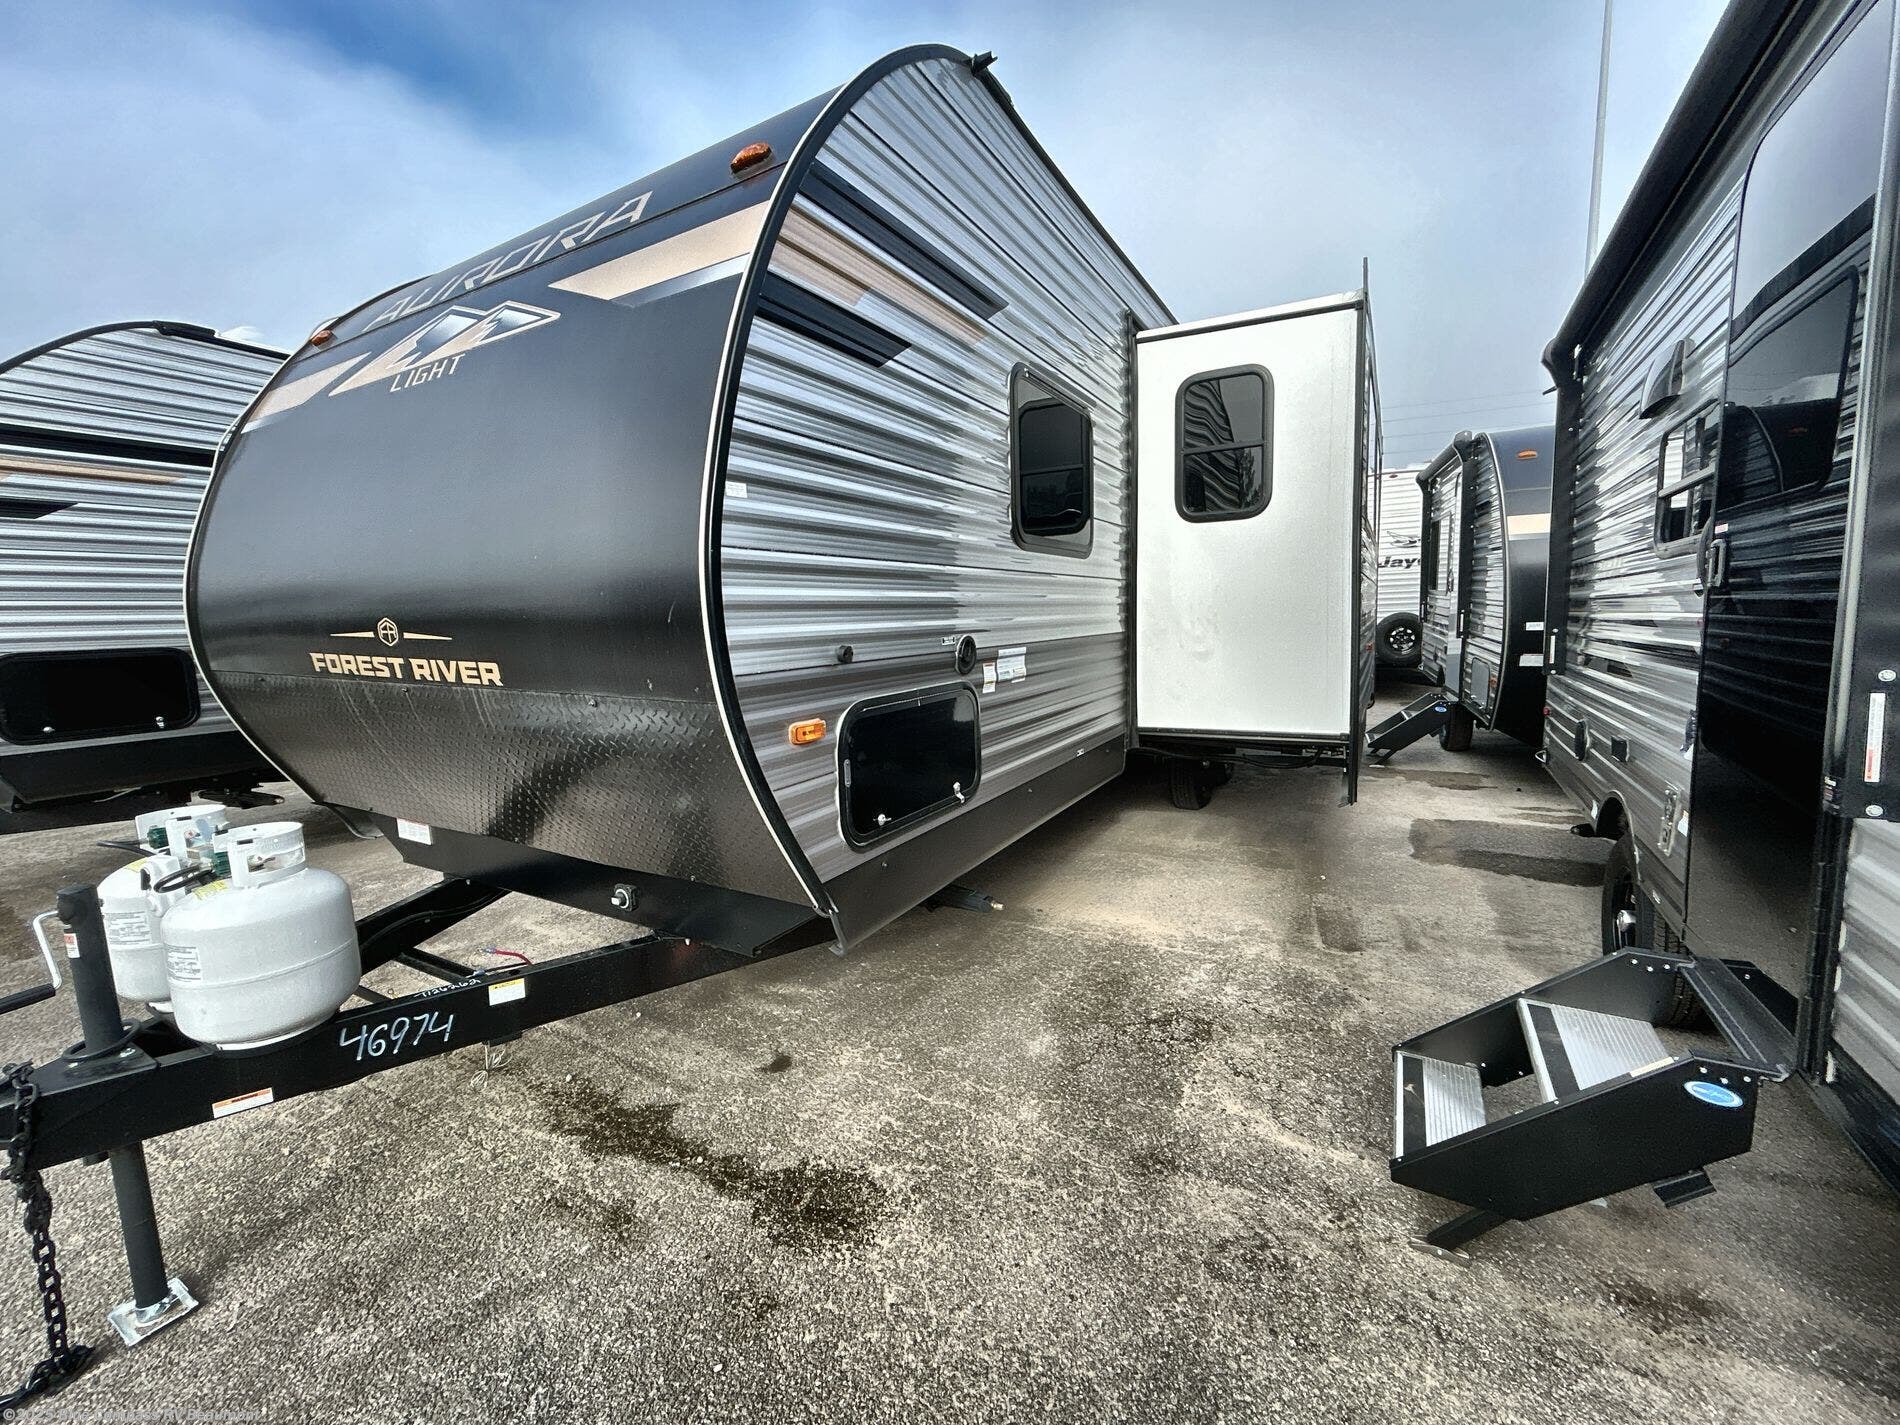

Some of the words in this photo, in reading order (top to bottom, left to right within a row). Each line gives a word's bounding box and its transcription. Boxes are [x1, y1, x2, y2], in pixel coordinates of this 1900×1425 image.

[362, 190, 653, 333] AURORA
[390, 353, 465, 393] LIGHT
[1377, 556, 1421, 570] Jay
[309, 652, 405, 679] FOREST
[408, 657, 504, 687] RIVER
[339, 1011, 454, 1061] 46974
